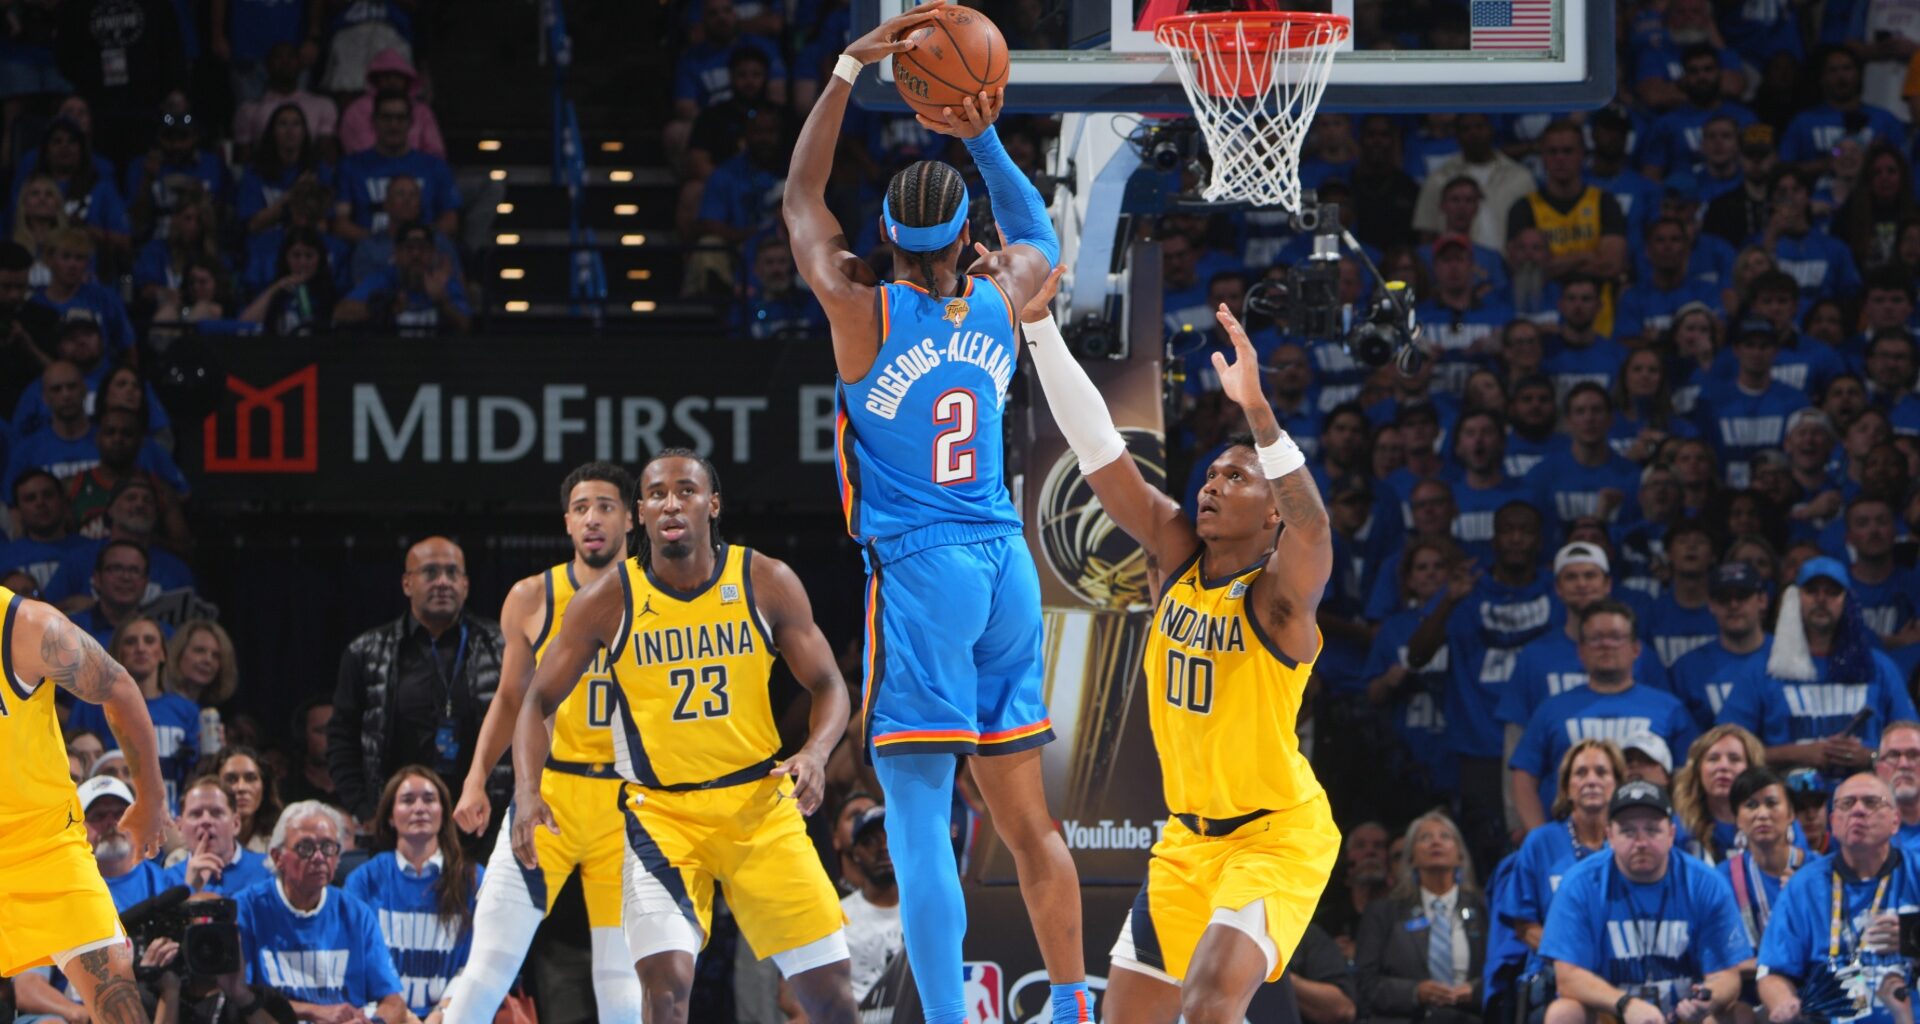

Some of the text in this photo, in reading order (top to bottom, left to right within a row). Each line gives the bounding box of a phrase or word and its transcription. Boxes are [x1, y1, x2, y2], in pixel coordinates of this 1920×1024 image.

[932, 387, 977, 486] 2
[633, 620, 755, 667] INDIANA
[668, 664, 732, 722] 23
[1166, 648, 1214, 716] 00
[1062, 818, 1166, 849] YouTube T
